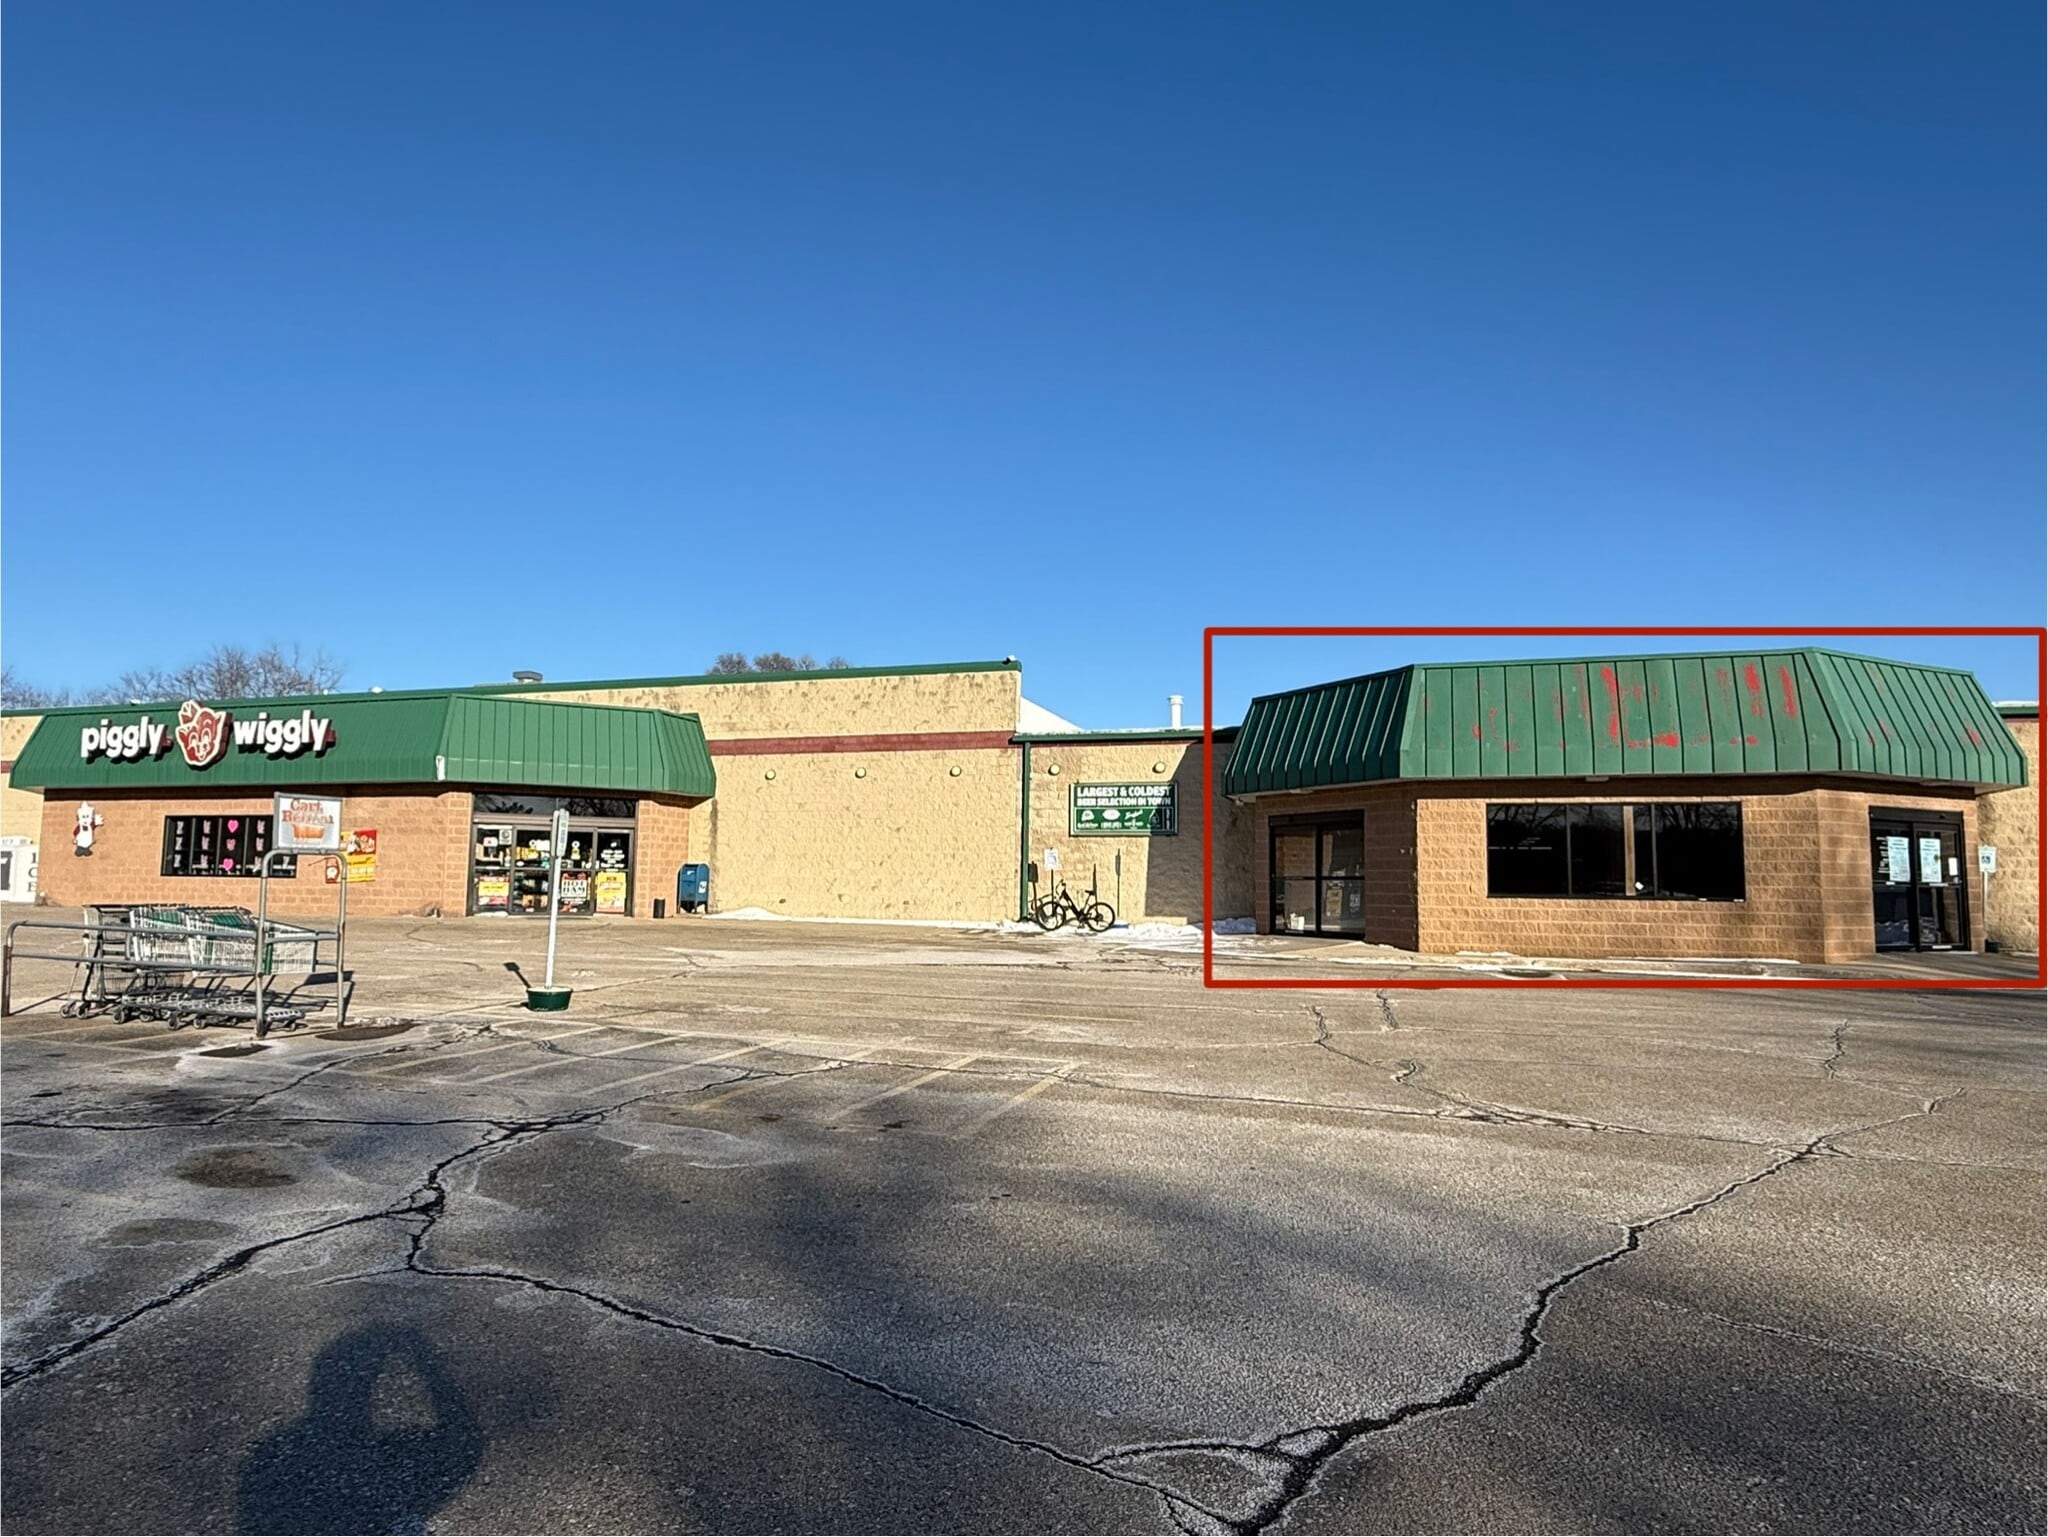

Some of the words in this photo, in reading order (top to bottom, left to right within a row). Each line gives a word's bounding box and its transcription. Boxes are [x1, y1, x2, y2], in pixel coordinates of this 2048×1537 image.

[81, 716, 164, 758] piggly
[232, 709, 330, 754] wiggly
[1077, 787, 1119, 797] LARGEST
[1120, 786, 1127, 797] &
[1128, 786, 1171, 797] COLDEST
[290, 797, 322, 812] Cart
[1077, 798, 1097, 807] BEER
[1097, 798, 1137, 807] SELECTION
[1137, 798, 1146, 806] IN
[1147, 797, 1171, 806] TOWN
